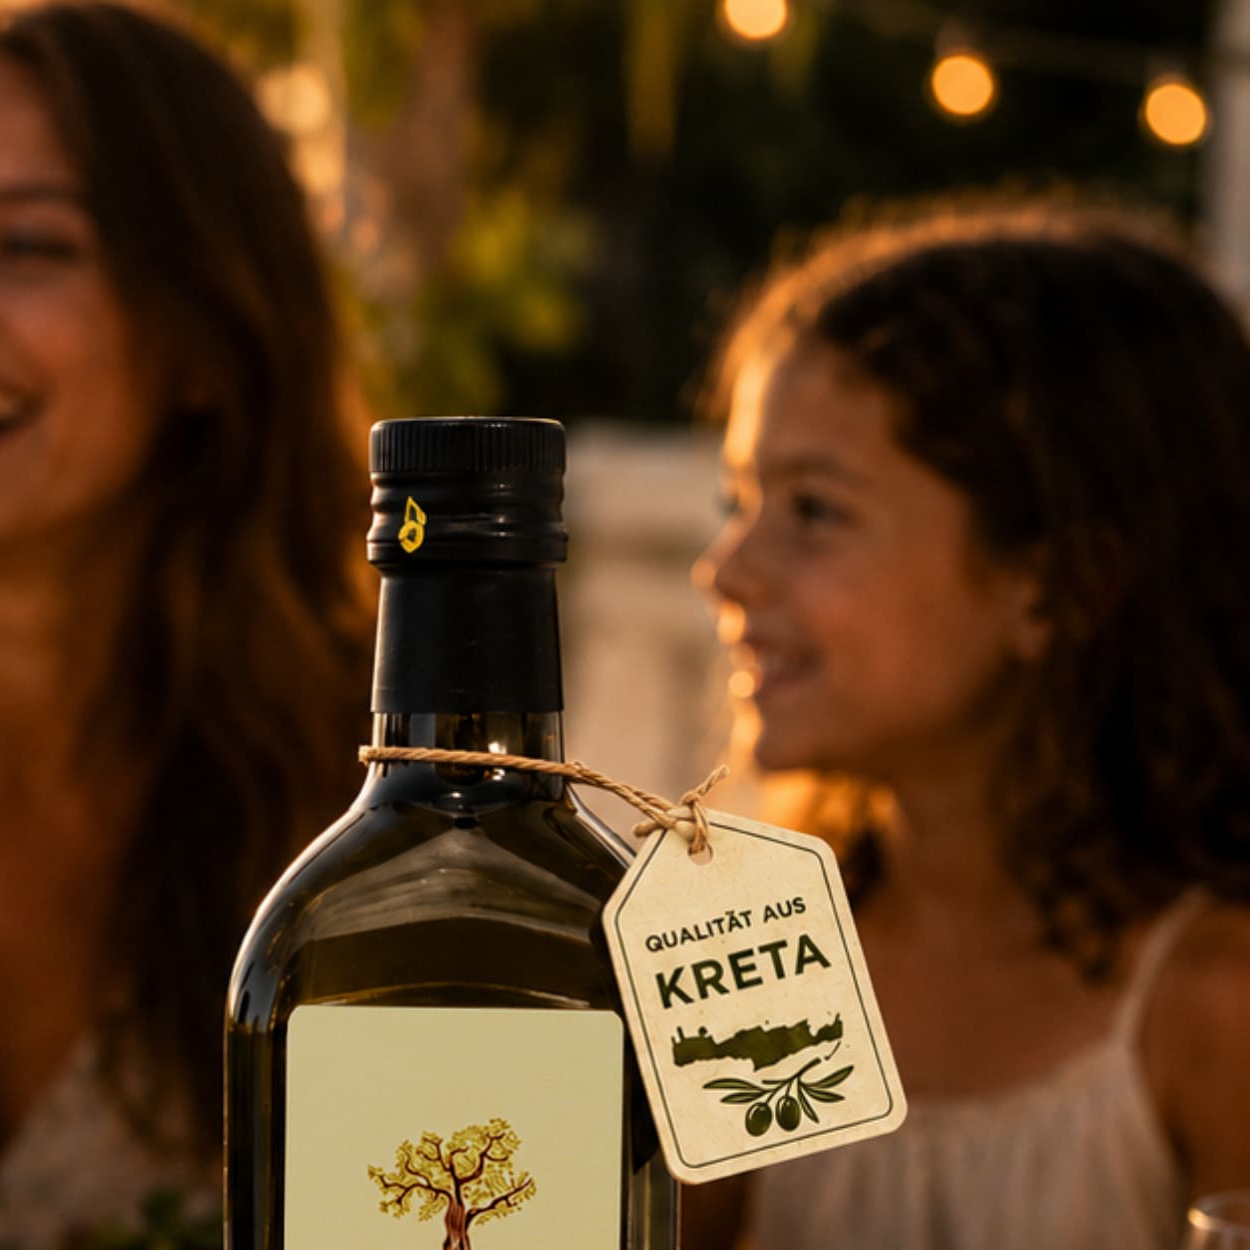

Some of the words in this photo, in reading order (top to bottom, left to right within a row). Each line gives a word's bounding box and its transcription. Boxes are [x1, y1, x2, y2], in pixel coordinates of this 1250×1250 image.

[645, 909, 753, 952] QUALITÄT
[763, 896, 806, 923] AUS
[655, 933, 832, 1009] KRETA
